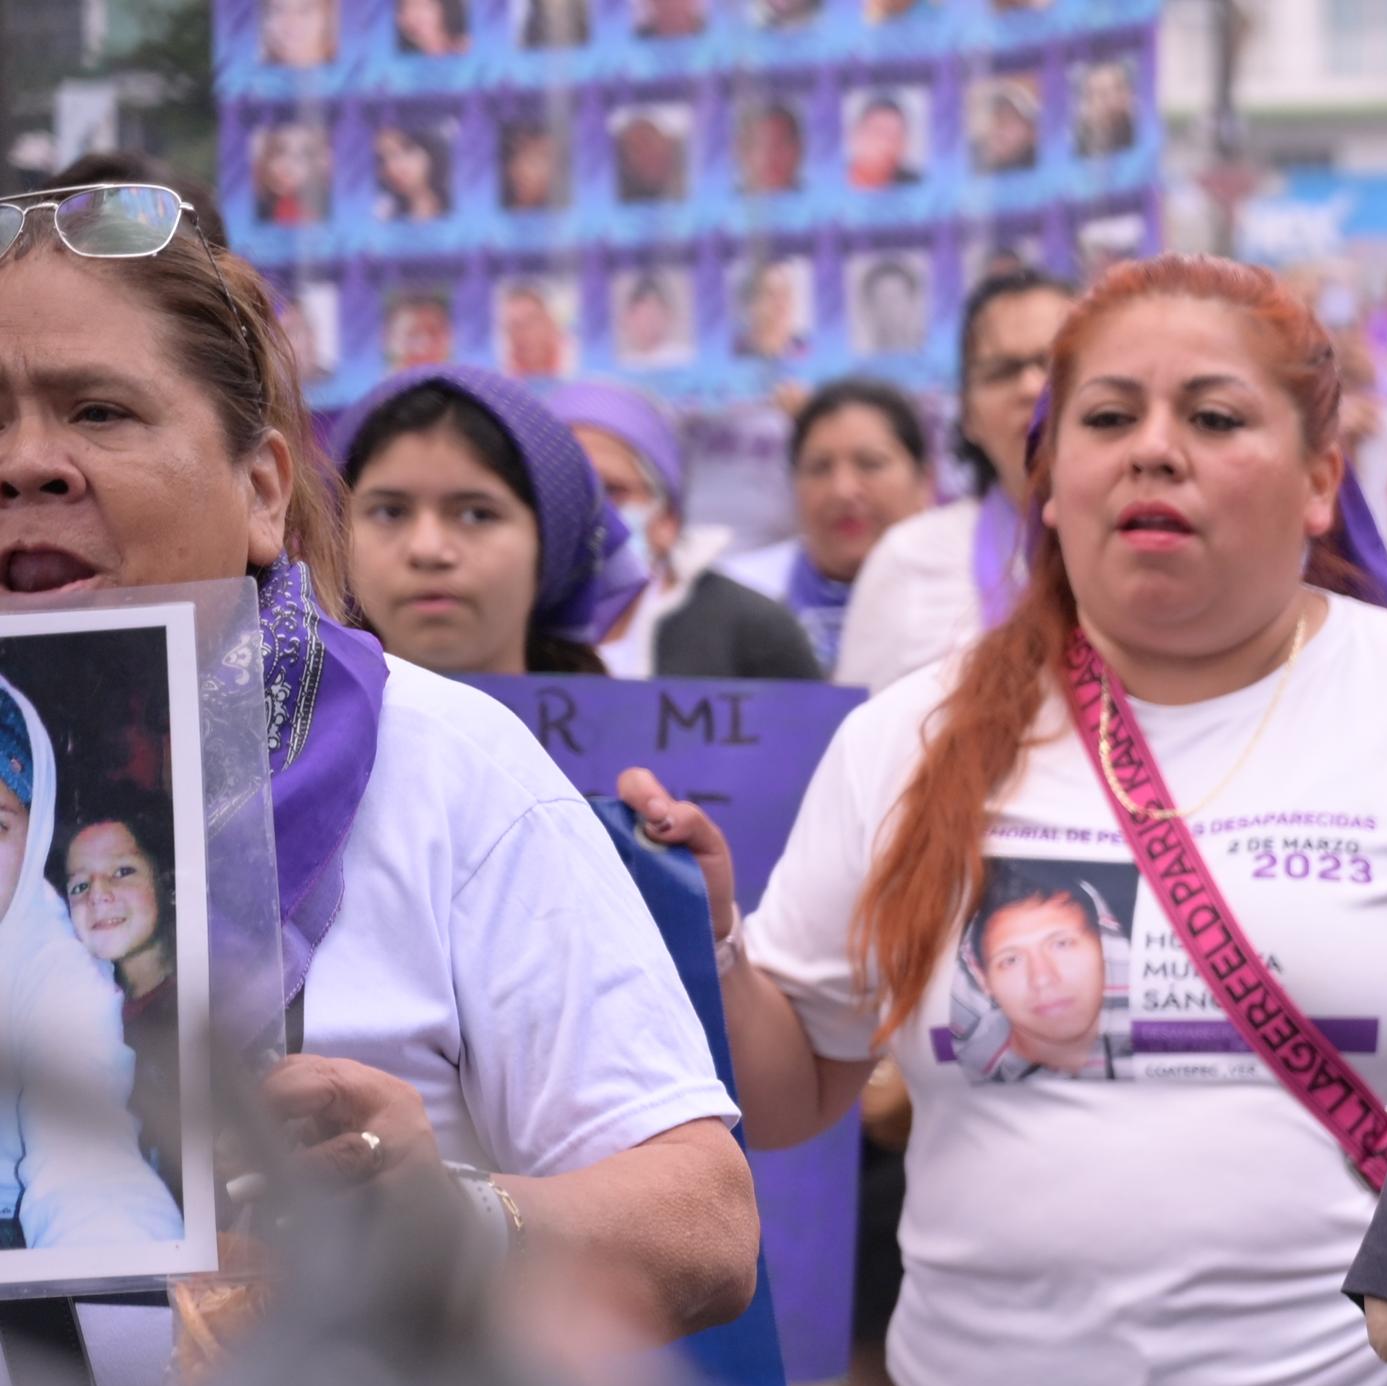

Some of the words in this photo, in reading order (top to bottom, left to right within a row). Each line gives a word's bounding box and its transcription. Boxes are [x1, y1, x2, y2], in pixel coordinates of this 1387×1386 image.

[1211, 811, 1378, 837] DESAPARECIDAS
[1247, 837, 1275, 853] DE
[1283, 838, 1361, 856] MARZO
[1251, 852, 1374, 884] 2023
[1181, 899, 1354, 1115] LAGERFELD
